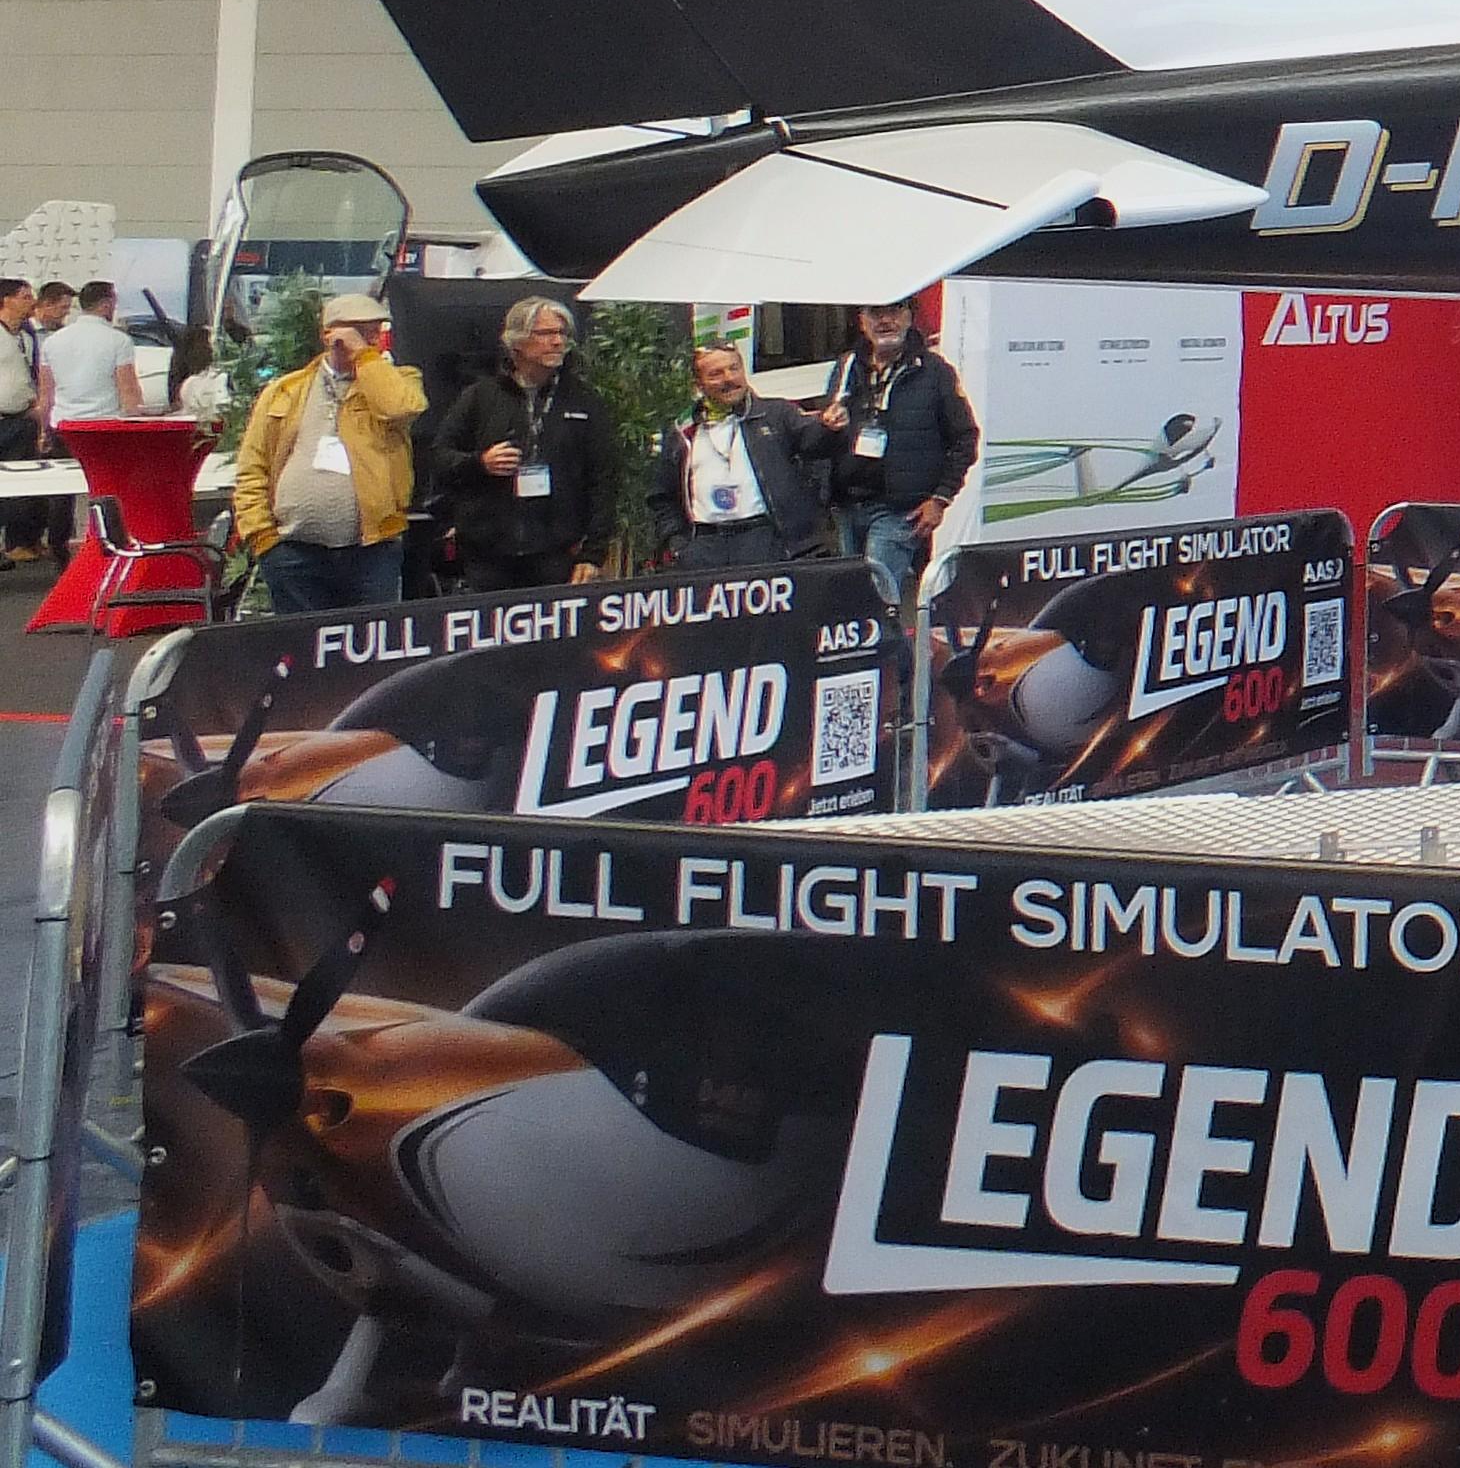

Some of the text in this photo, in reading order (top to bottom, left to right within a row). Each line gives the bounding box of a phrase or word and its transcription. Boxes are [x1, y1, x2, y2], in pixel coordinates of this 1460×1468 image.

[1262, 293, 1389, 345] ALTUS
[1023, 523, 1291, 583] FULL FLIGHT SIMULATOR
[1303, 560, 1335, 583] AAS
[315, 577, 793, 668] FULL FLIGHT SIMULATOR
[818, 620, 860, 654] AAS
[1129, 591, 1286, 721] LEGEND
[1223, 668, 1285, 723] 600
[514, 662, 787, 817] LEGEND
[684, 760, 778, 825] 600
[437, 842, 645, 924] FULL
[676, 855, 979, 943] FLIGHT
[460, 1386, 656, 1441] REALITÄT
